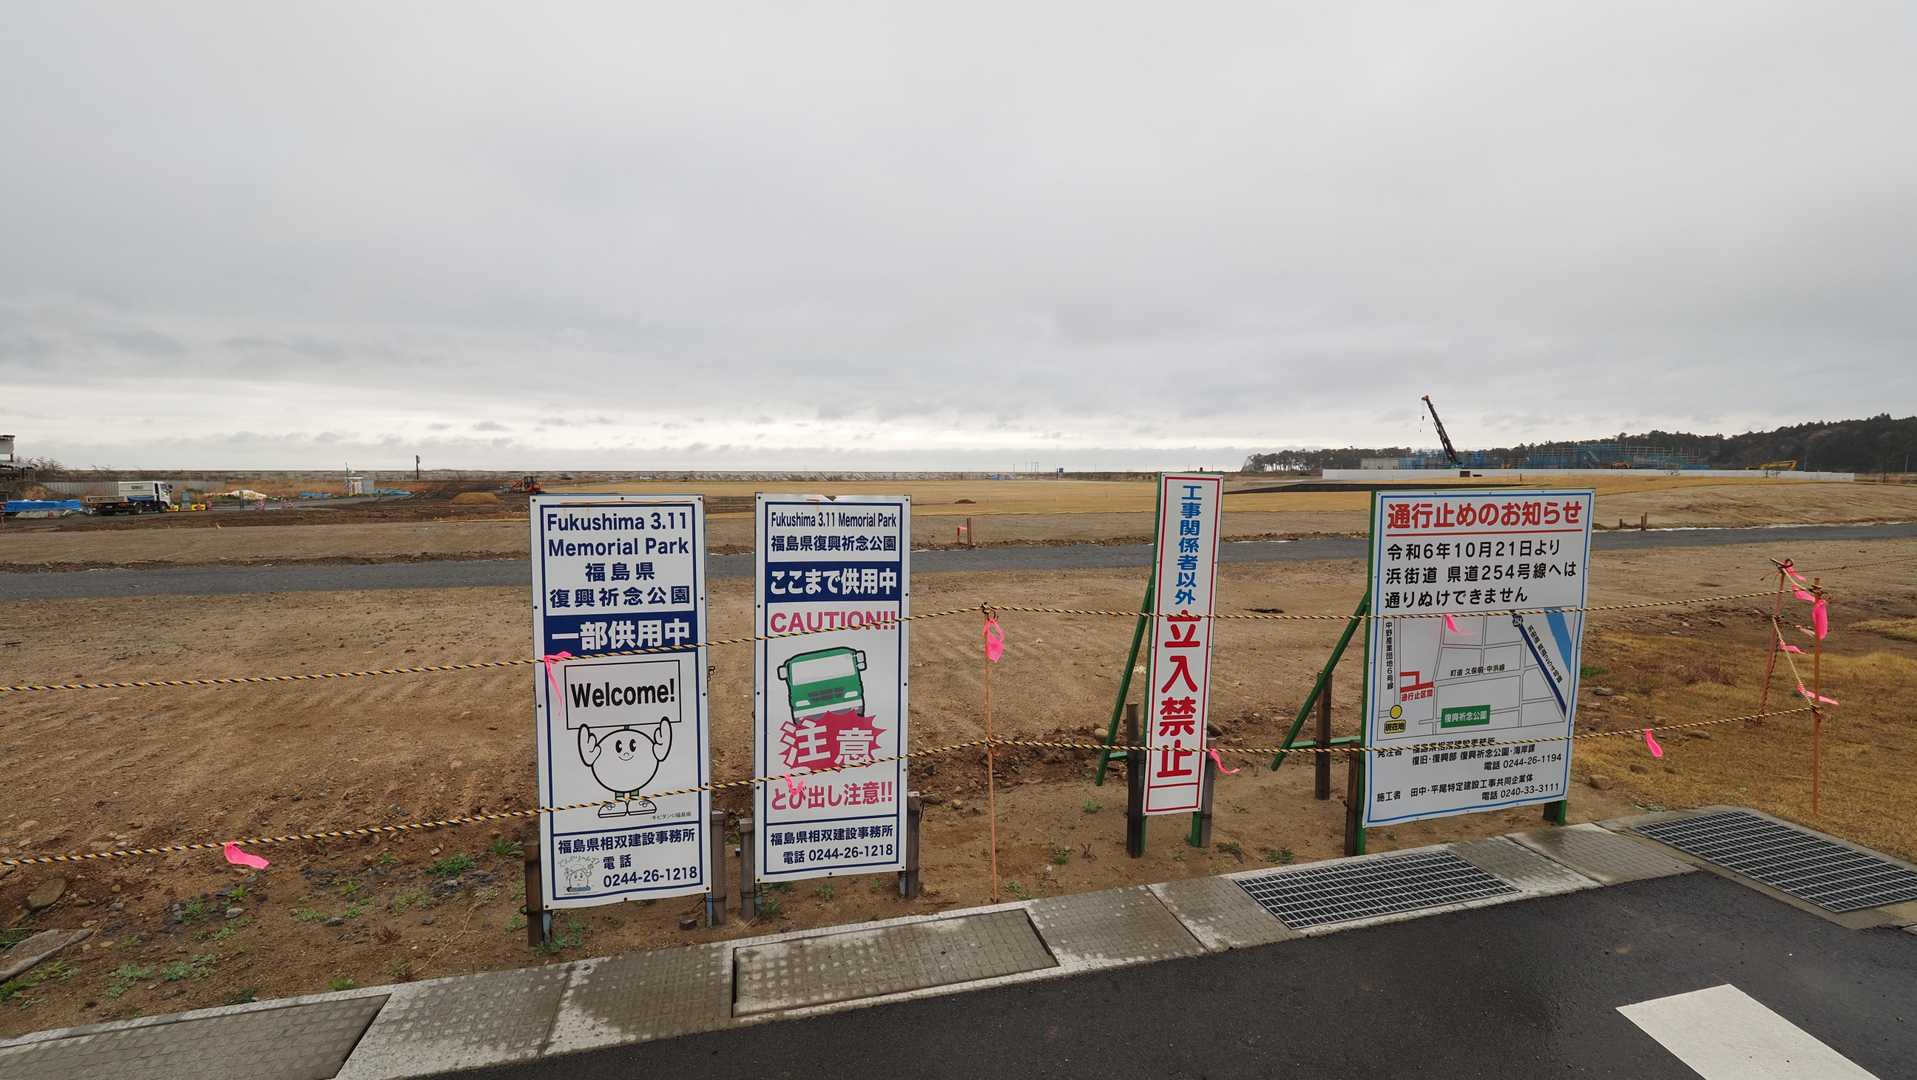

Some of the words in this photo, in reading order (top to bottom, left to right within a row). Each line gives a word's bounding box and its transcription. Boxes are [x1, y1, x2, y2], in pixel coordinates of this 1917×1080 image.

[547, 513, 645, 532] Fukushima
[650, 512, 687, 530] 3.11
[771, 512, 816, 528] Fukushima
[818, 512, 836, 527] 3.11
[838, 512, 876, 527] Memorial
[877, 512, 897, 527] Park
[1386, 501, 1582, 529] 通行止めのお知らせ
[548, 538, 639, 557] Memorial
[645, 537, 690, 555] Park
[770, 535, 897, 552] 福島県復興祈念公園
[1174, 485, 1202, 606] 工事関係者以外
[1386, 539, 1560, 561] 令和6年10月21日より
[585, 562, 656, 582] 福島県
[770, 567, 897, 595] ここまで供用中
[1385, 567, 1438, 585] 浜街道
[1447, 561, 1577, 583] 県道254号線へは
[549, 585, 691, 609] 復興祈念公園
[1384, 586, 1528, 609] 通りぬけできません
[770, 611, 896, 633] CAUTION!!
[551, 618, 691, 650] 一部供用中
[570, 678, 676, 708] Welcome!
[1156, 609, 1201, 779] 立入禁止
[779, 719, 874, 768] 注意
[1503, 753, 1562, 769] 0244-26-1194
[1500, 783, 1560, 799] 0240-33-3111
[557, 827, 696, 854] 福島県相双建設事務所
[770, 824, 894, 846] 福島県相双建設事務所
[602, 854, 632, 870] 電話
[783, 850, 805, 865] 電話
[808, 844, 893, 862] 0244-26-1218
[602, 866, 698, 888] 0244-26-1218
